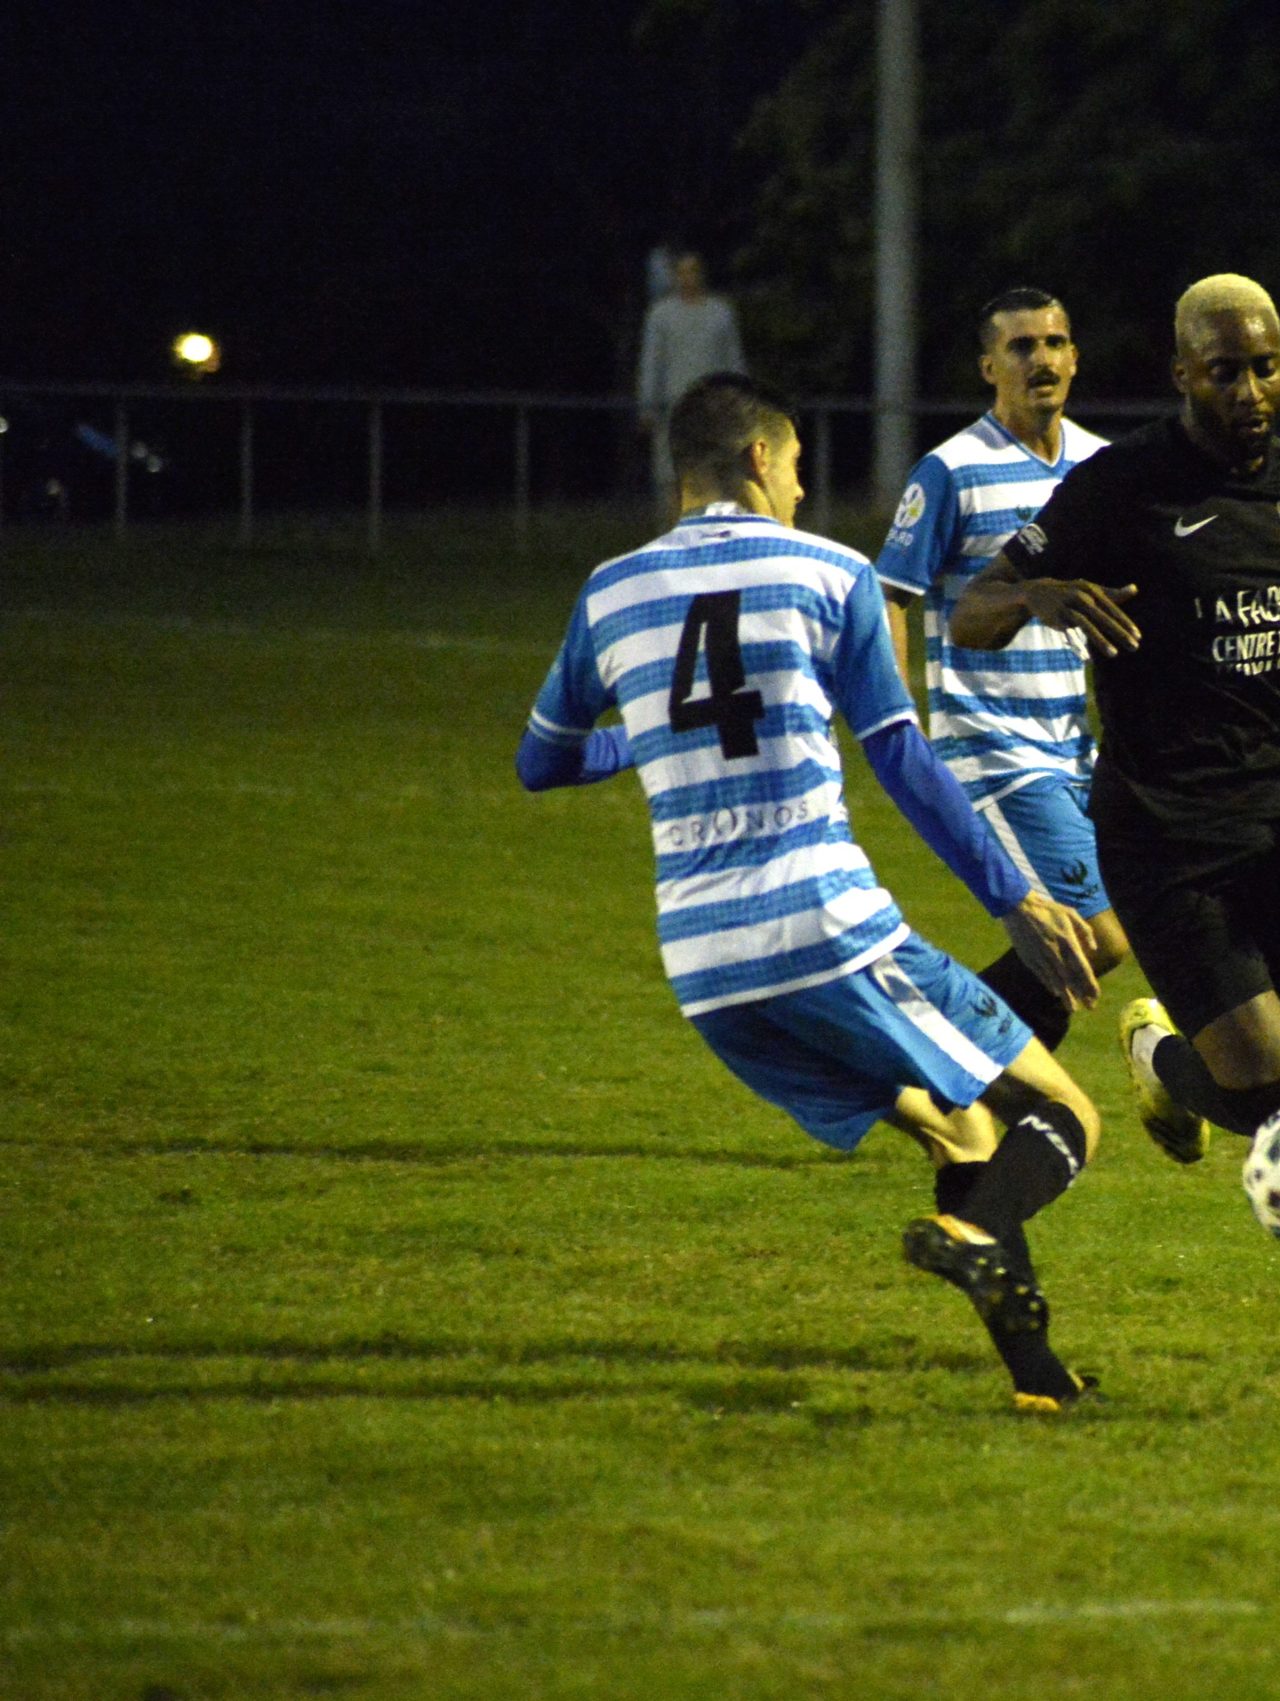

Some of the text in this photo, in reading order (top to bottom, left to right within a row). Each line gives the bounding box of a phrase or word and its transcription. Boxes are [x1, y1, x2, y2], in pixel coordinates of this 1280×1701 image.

[1212, 630, 1275, 661] CENTRE
[670, 591, 764, 758] 4
[668, 801, 808, 846] CRONOS
